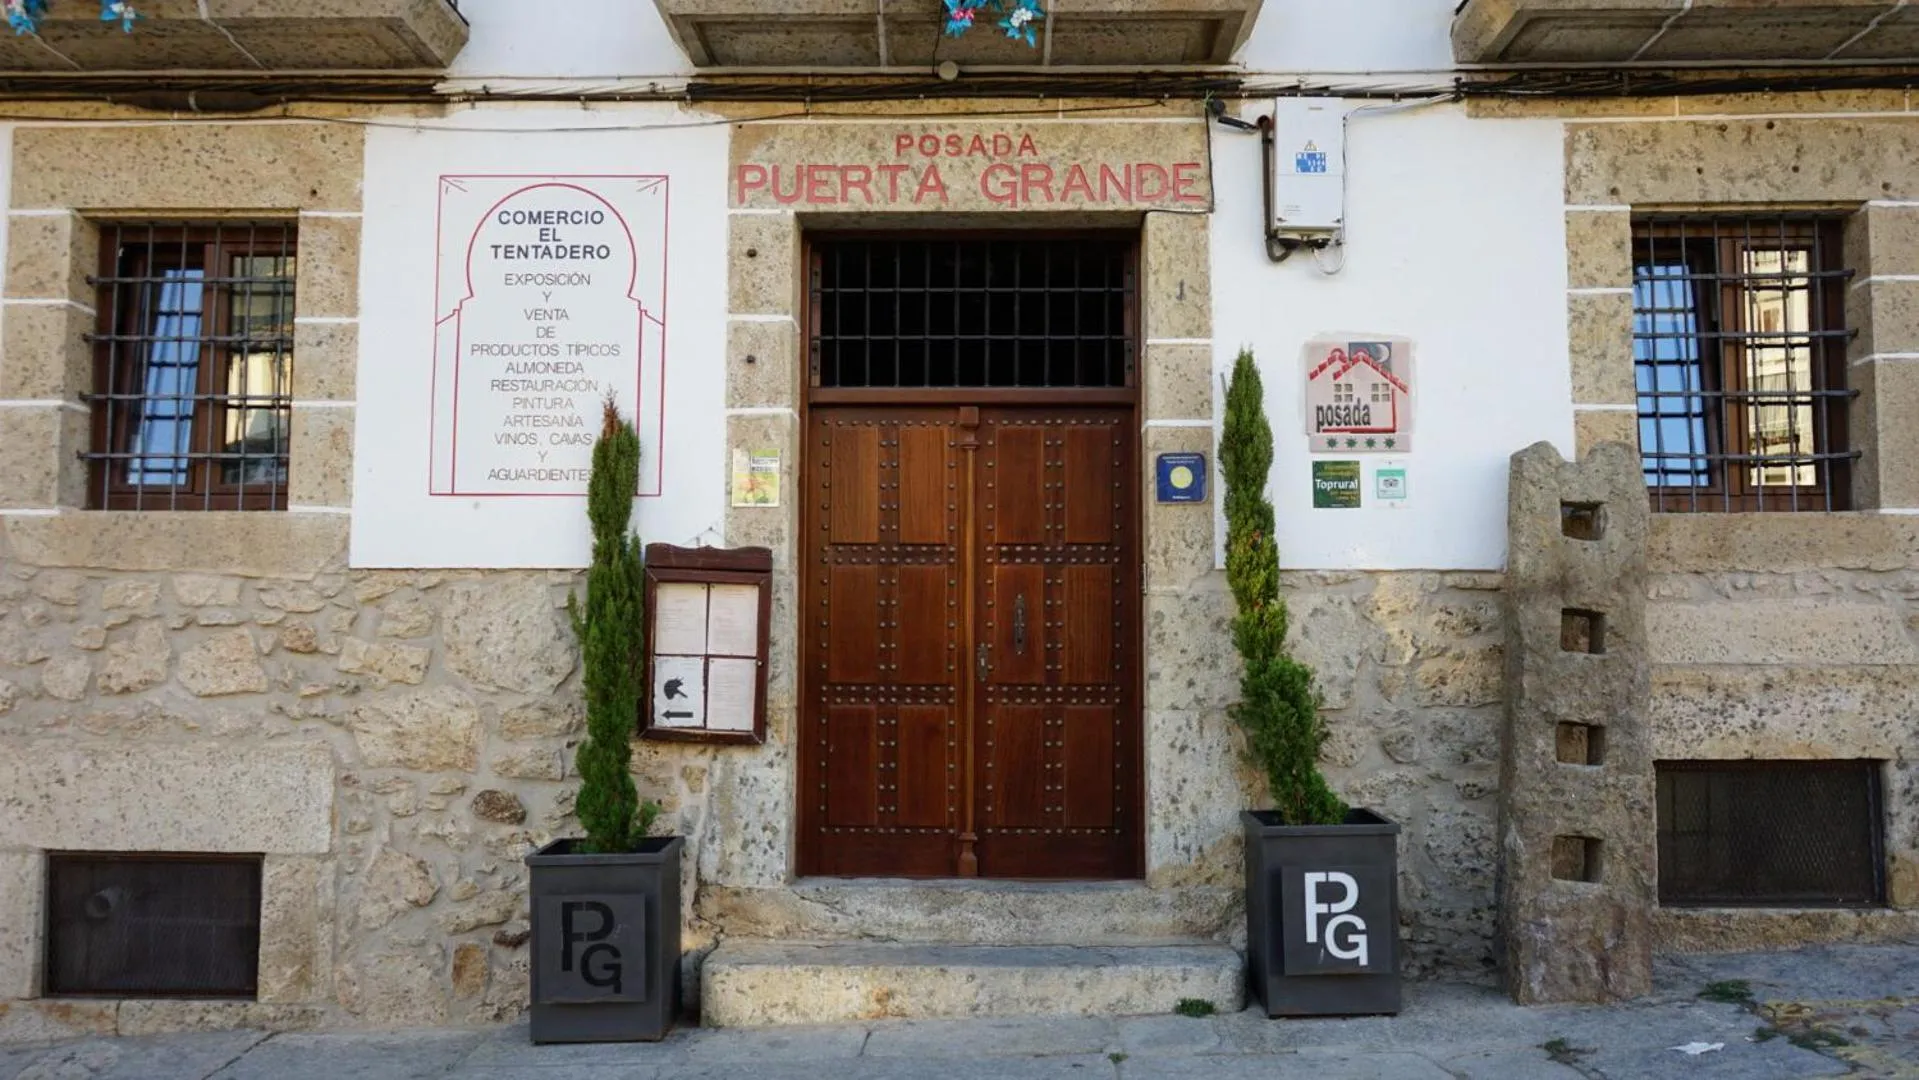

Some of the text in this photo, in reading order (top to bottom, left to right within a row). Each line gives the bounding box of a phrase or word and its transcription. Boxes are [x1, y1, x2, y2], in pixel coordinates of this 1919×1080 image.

[896, 132, 1038, 158] POSADA
[736, 162, 1201, 208] PUERTA GRANDE
[498, 210, 605, 225] COMERCIO
[539, 227, 562, 242] EL
[490, 244, 611, 260] TENTADERO
[504, 271, 591, 286] EXPOSICIÓN
[542, 291, 552, 303] Y
[523, 308, 569, 321] VENTA
[536, 326, 556, 339] DE
[471, 341, 621, 357] PRODUCTOS TÍPICOS
[505, 361, 585, 375] ALMONEDA
[490, 377, 598, 393] RESTAURACIÓN
[513, 397, 574, 410] PINTURA
[503, 414, 584, 428] ARTESANÍA
[1316, 397, 1371, 432] posada
[549, 431, 593, 446] CAVAS
[538, 450, 548, 463] Y
[1315, 479, 1358, 491] Toprural
